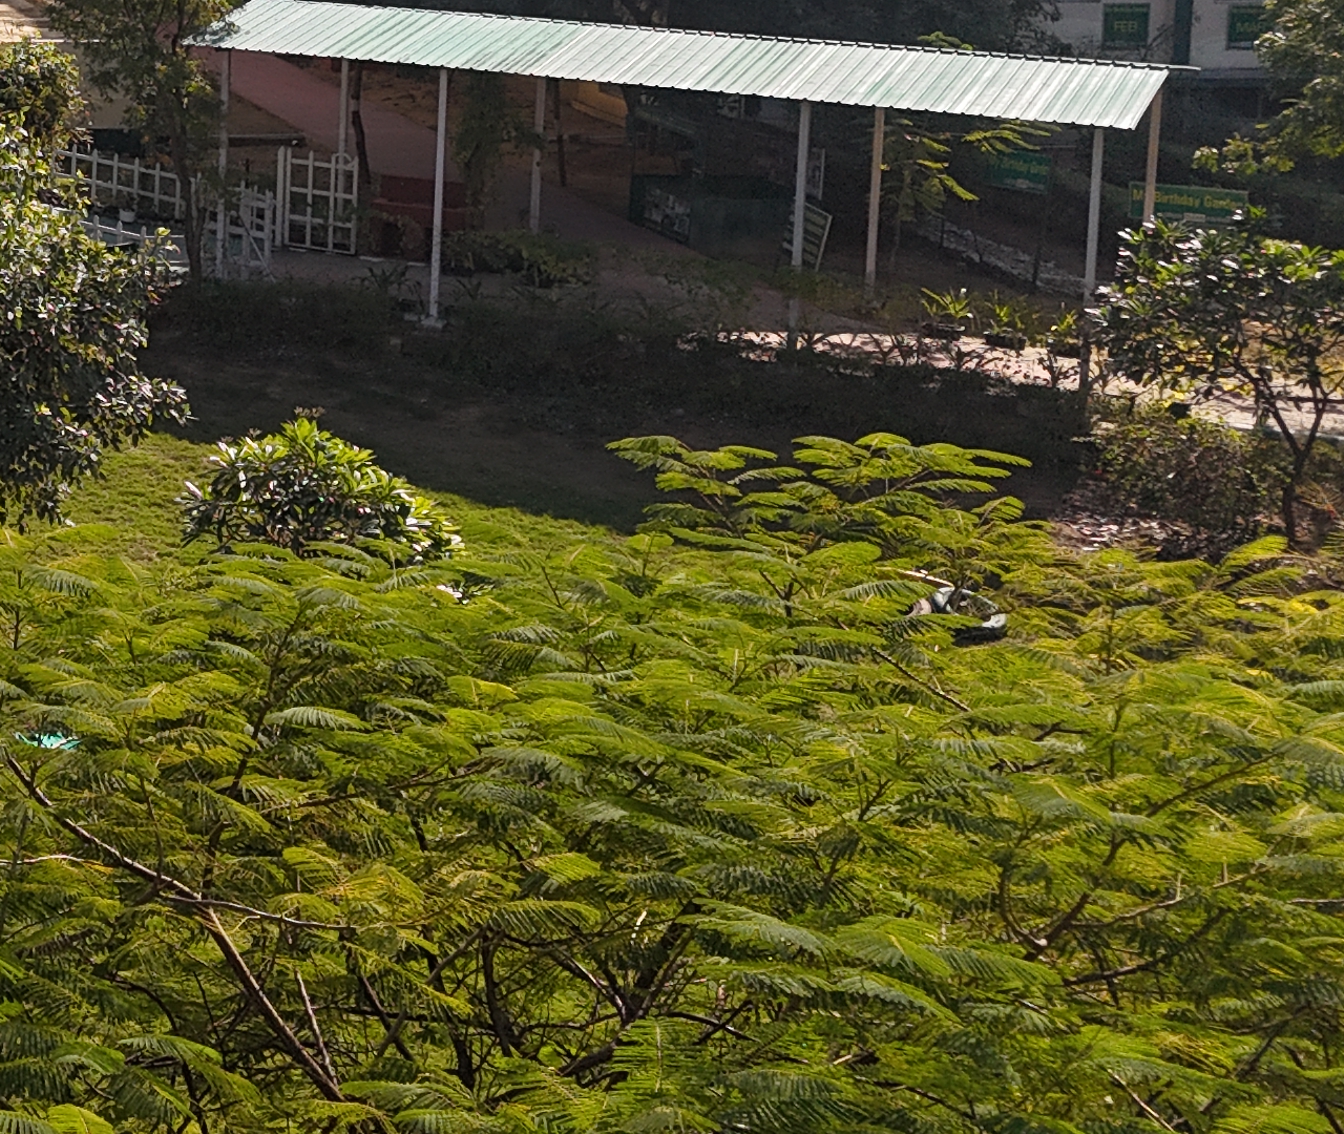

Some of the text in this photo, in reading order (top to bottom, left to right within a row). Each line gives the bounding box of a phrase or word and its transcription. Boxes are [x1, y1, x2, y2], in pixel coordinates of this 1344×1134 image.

[1114, 21, 1138, 32] FEB
[1154, 191, 1200, 208] Birthday
[1205, 195, 1243, 210] Garde
